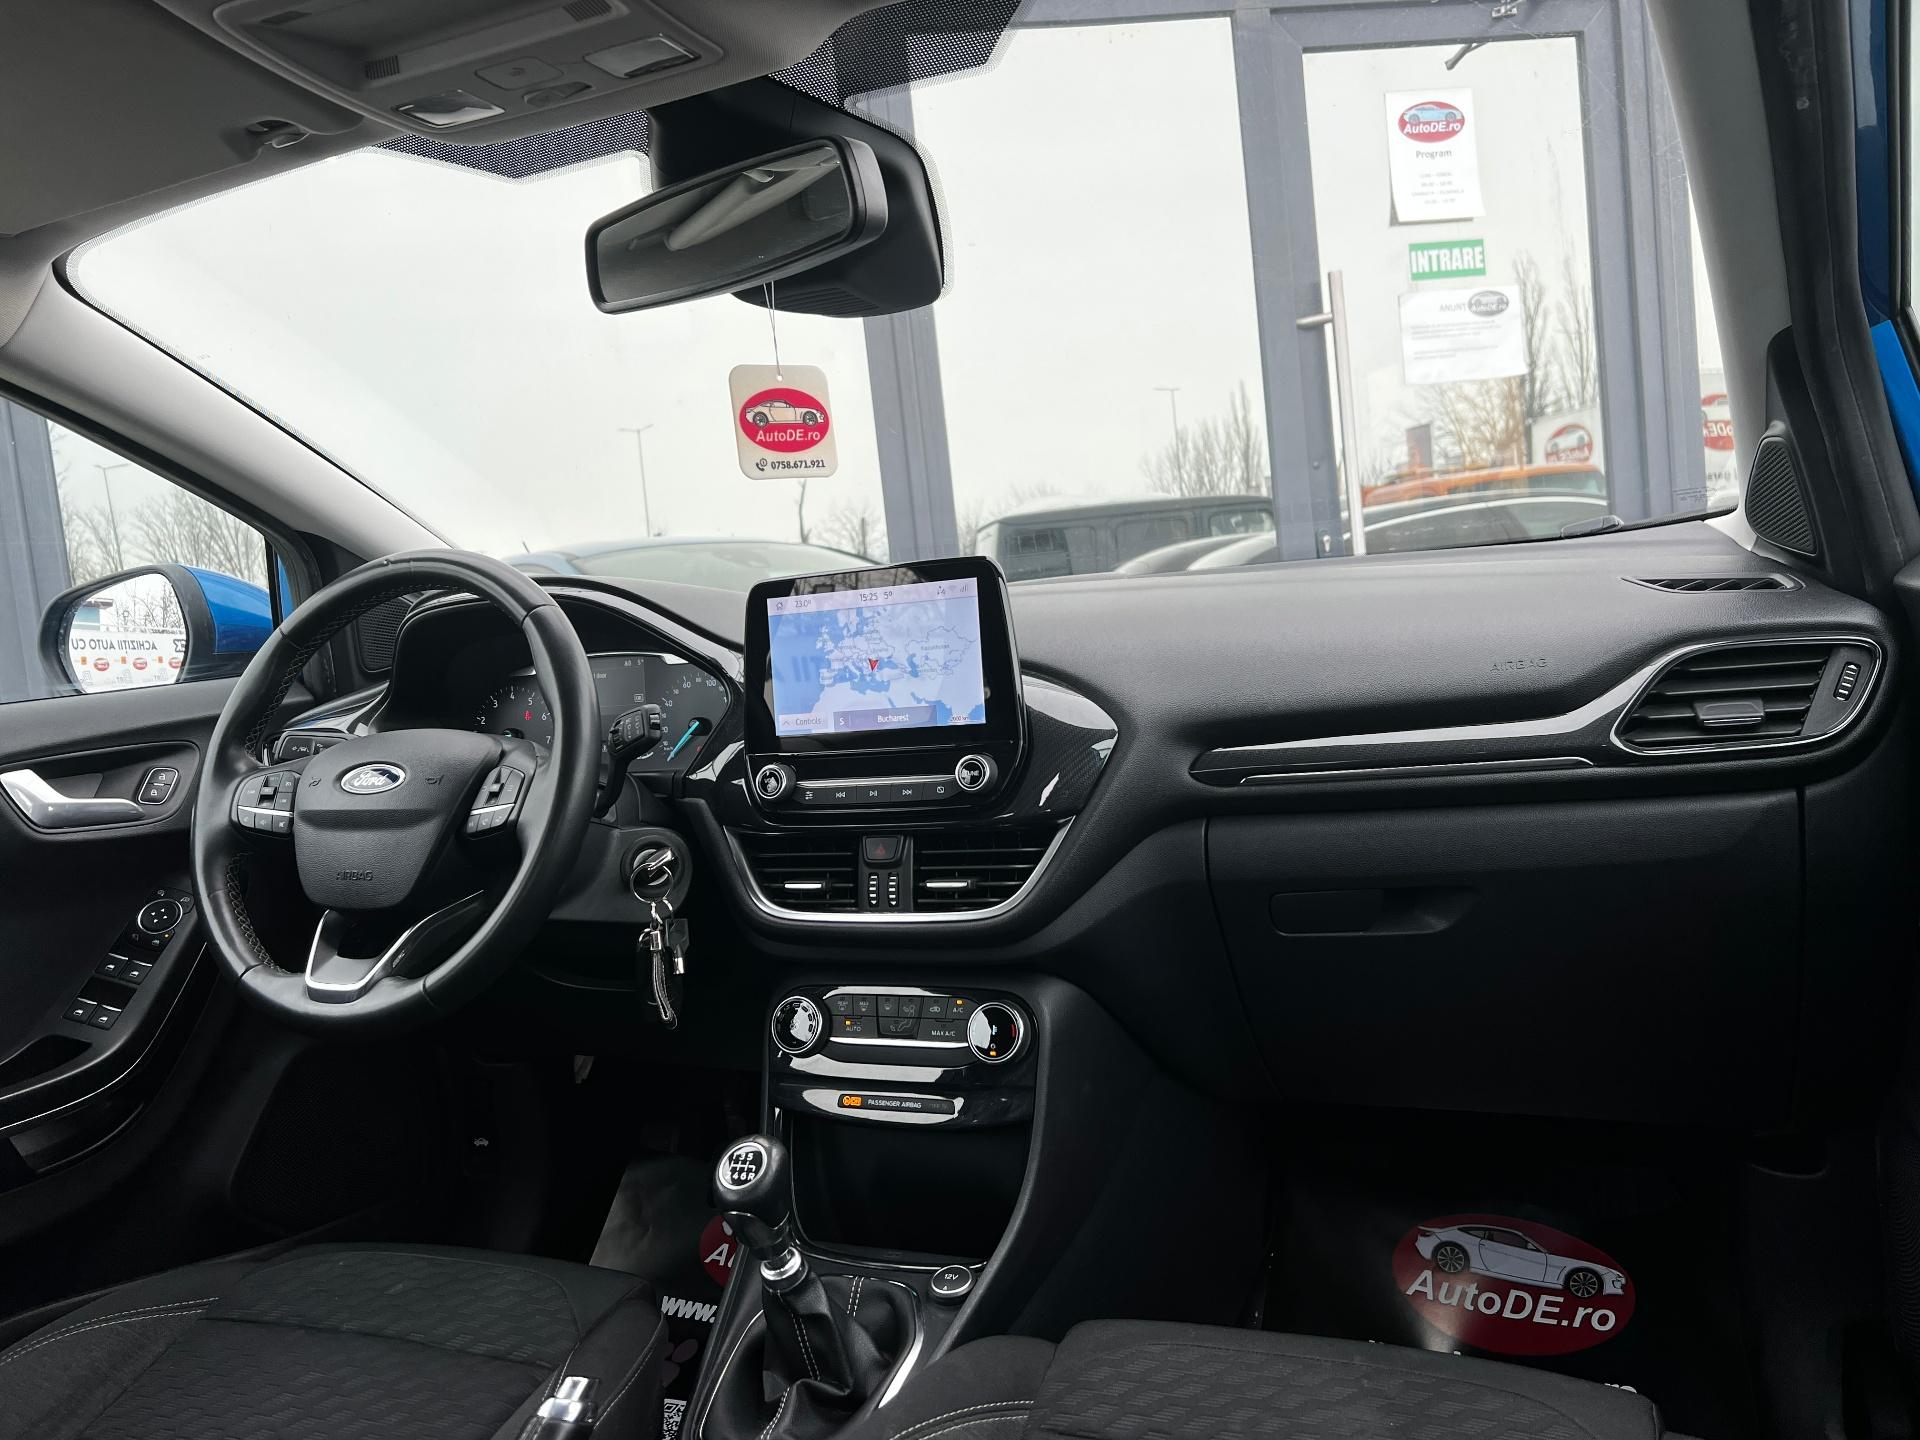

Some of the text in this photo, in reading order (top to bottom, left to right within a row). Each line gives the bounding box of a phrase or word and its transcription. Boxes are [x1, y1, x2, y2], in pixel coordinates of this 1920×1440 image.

[1403, 121, 1461, 134] AutoDE.ro
[1415, 149, 1452, 160] Program
[1410, 246, 1484, 273] INTRARE
[756, 429, 820, 442] AutoDE.ro
[771, 460, 826, 470] 0758.671.921
[860, 592, 878, 602] 15:25
[1489, 658, 1546, 672] AIRBAG
[682, 681, 692, 689] 60
[510, 692, 515, 700] 4
[493, 700, 498, 708] 3
[528, 698, 533, 706] 5
[480, 717, 486, 725] 2
[541, 712, 547, 721] 6
[877, 713, 909, 723] Bucharest
[546, 736, 551, 744] 7
[352, 770, 389, 787] Ford
[867, 1099, 900, 1107] PASSENGER
[901, 1100, 922, 1109] AIRBAG
[746, 1152, 754, 1161] 5
[732, 1172, 739, 1180] 4
[740, 1172, 747, 1180] 6
[747, 1172, 755, 1181] R
[1406, 1269, 1616, 1332] AutoDE.ro
